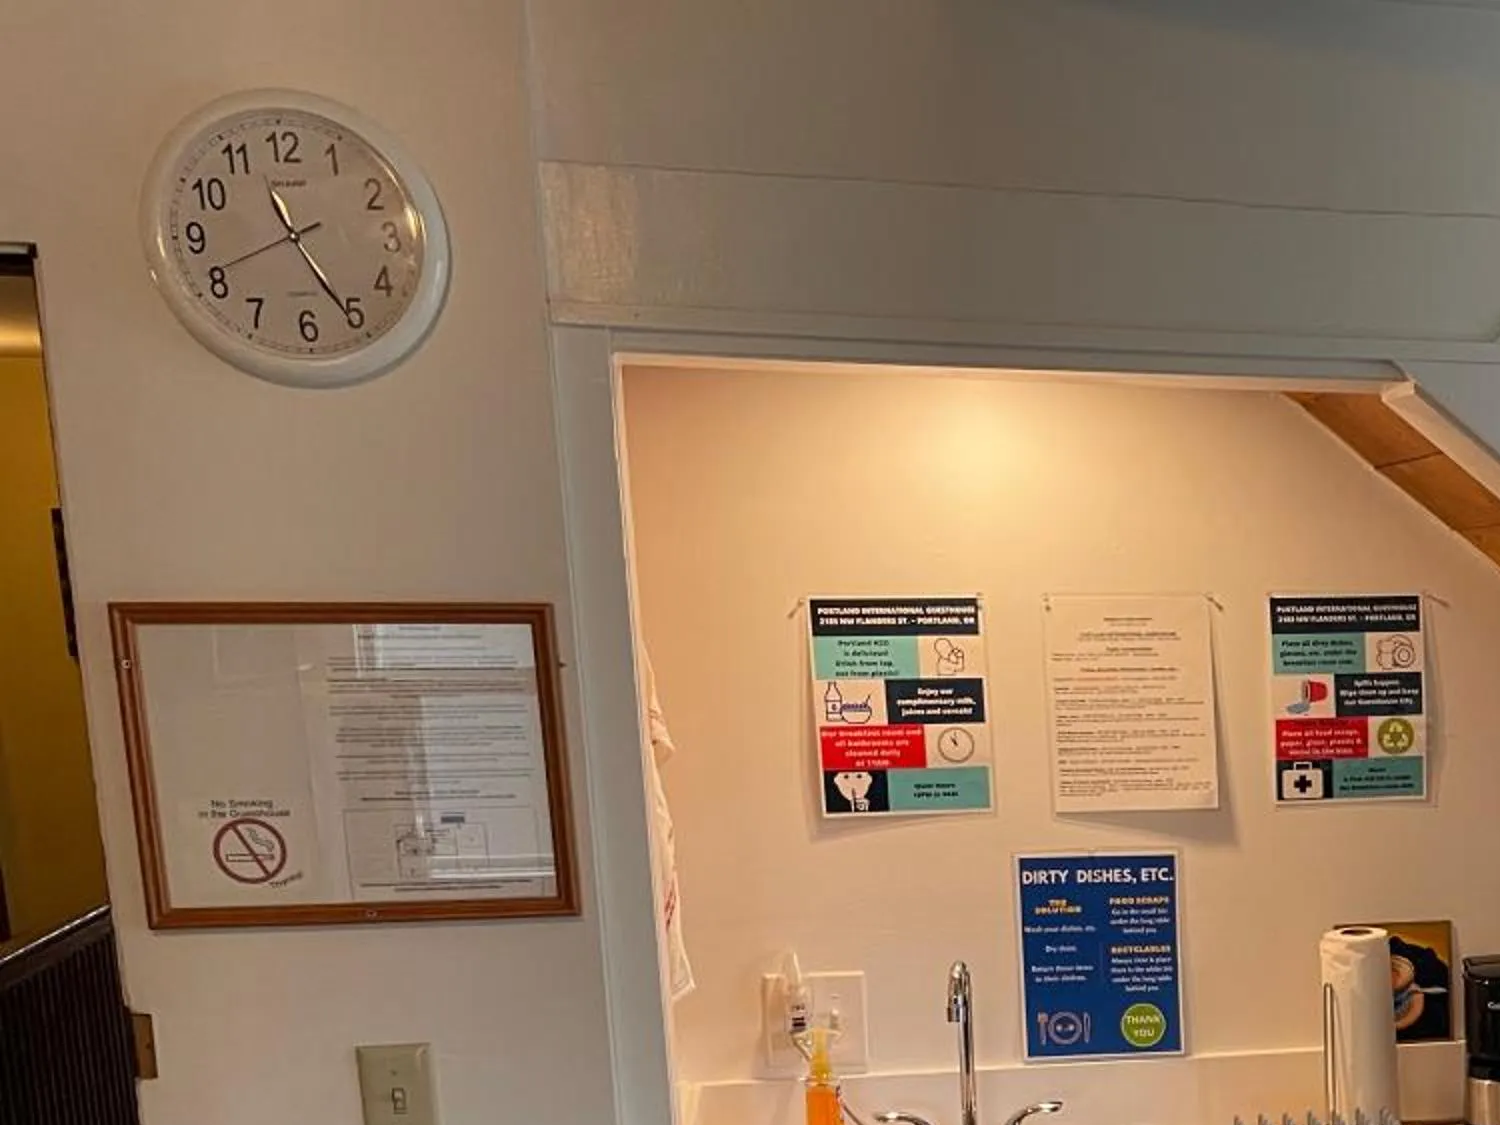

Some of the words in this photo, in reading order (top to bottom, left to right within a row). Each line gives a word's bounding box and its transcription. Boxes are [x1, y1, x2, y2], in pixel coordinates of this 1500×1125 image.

[221, 143, 250, 175] 11
[265, 130, 302, 163] 12
[325, 143, 339, 176] 1
[191, 177, 226, 211] 10
[363, 178, 385, 211] 2
[185, 221, 206, 254] 9
[381, 221, 401, 253] 3
[209, 265, 229, 299] 8
[373, 265, 394, 297] 4
[245, 297, 264, 329] 7
[298, 310, 319, 342] 6
[344, 297, 364, 329] 5
[817, 607, 860, 615] PORTLAND
[861, 607, 925, 615] INTERNATIONAL
[917, 687, 939, 696] Enjoy
[210, 799, 227, 808] No
[228, 799, 273, 809] Smoking
[210, 809, 227, 818] the
[1023, 870, 1069, 885] DIRTY
[1077, 869, 1137, 884] DISHES,
[1141, 867, 1174, 882] ETC.
[1126, 1015, 1160, 1025] THANK
[1134, 1028, 1155, 1037] YOU
